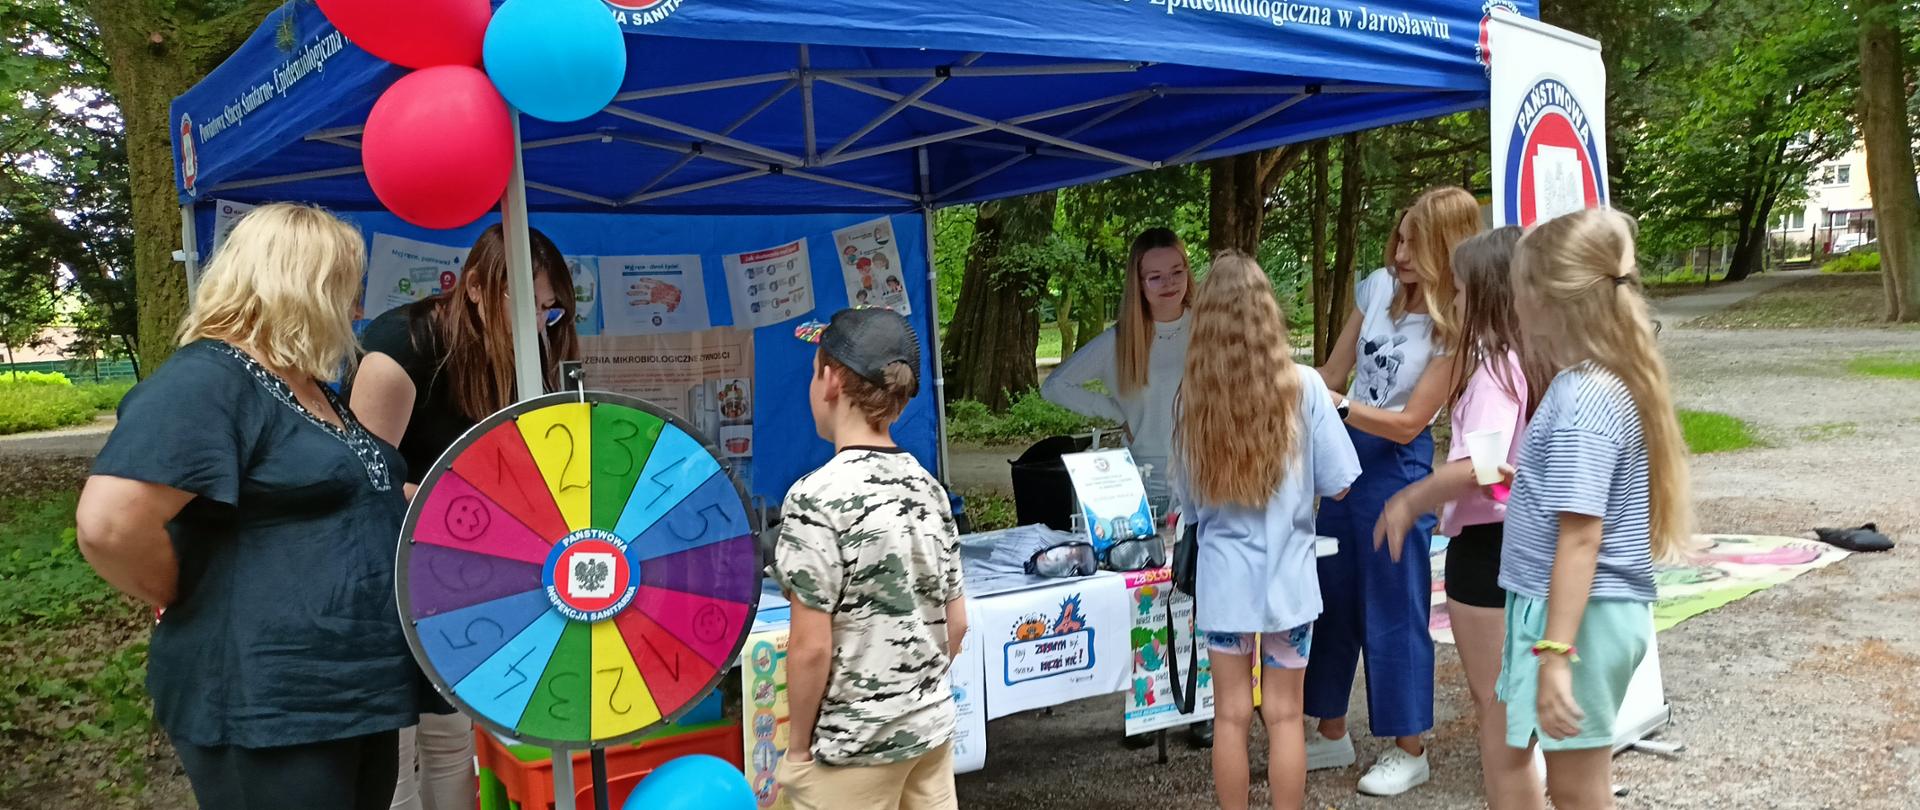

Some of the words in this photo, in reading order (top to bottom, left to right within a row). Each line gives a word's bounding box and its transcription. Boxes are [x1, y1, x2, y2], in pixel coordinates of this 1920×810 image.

[1337, 9, 1352, 28] w
[1357, 6, 1450, 39] Jarosławiu
[273, 30, 343, 98] Epidemiologiczna
[1517, 82, 1589, 146] PAŃSTWOWA
[545, 423, 591, 492] 2
[603, 419, 639, 477] 3
[645, 456, 687, 511] 4
[562, 529, 628, 553] PAŃSTWOWA
[666, 503, 731, 542] 5
[546, 585, 588, 621] INSPEKCJA
[590, 586, 636, 621] SANITARNA
[440, 617, 504, 650] 5
[494, 646, 537, 700] 4
[548, 672, 580, 721] 3
[597, 667, 632, 715] 2
